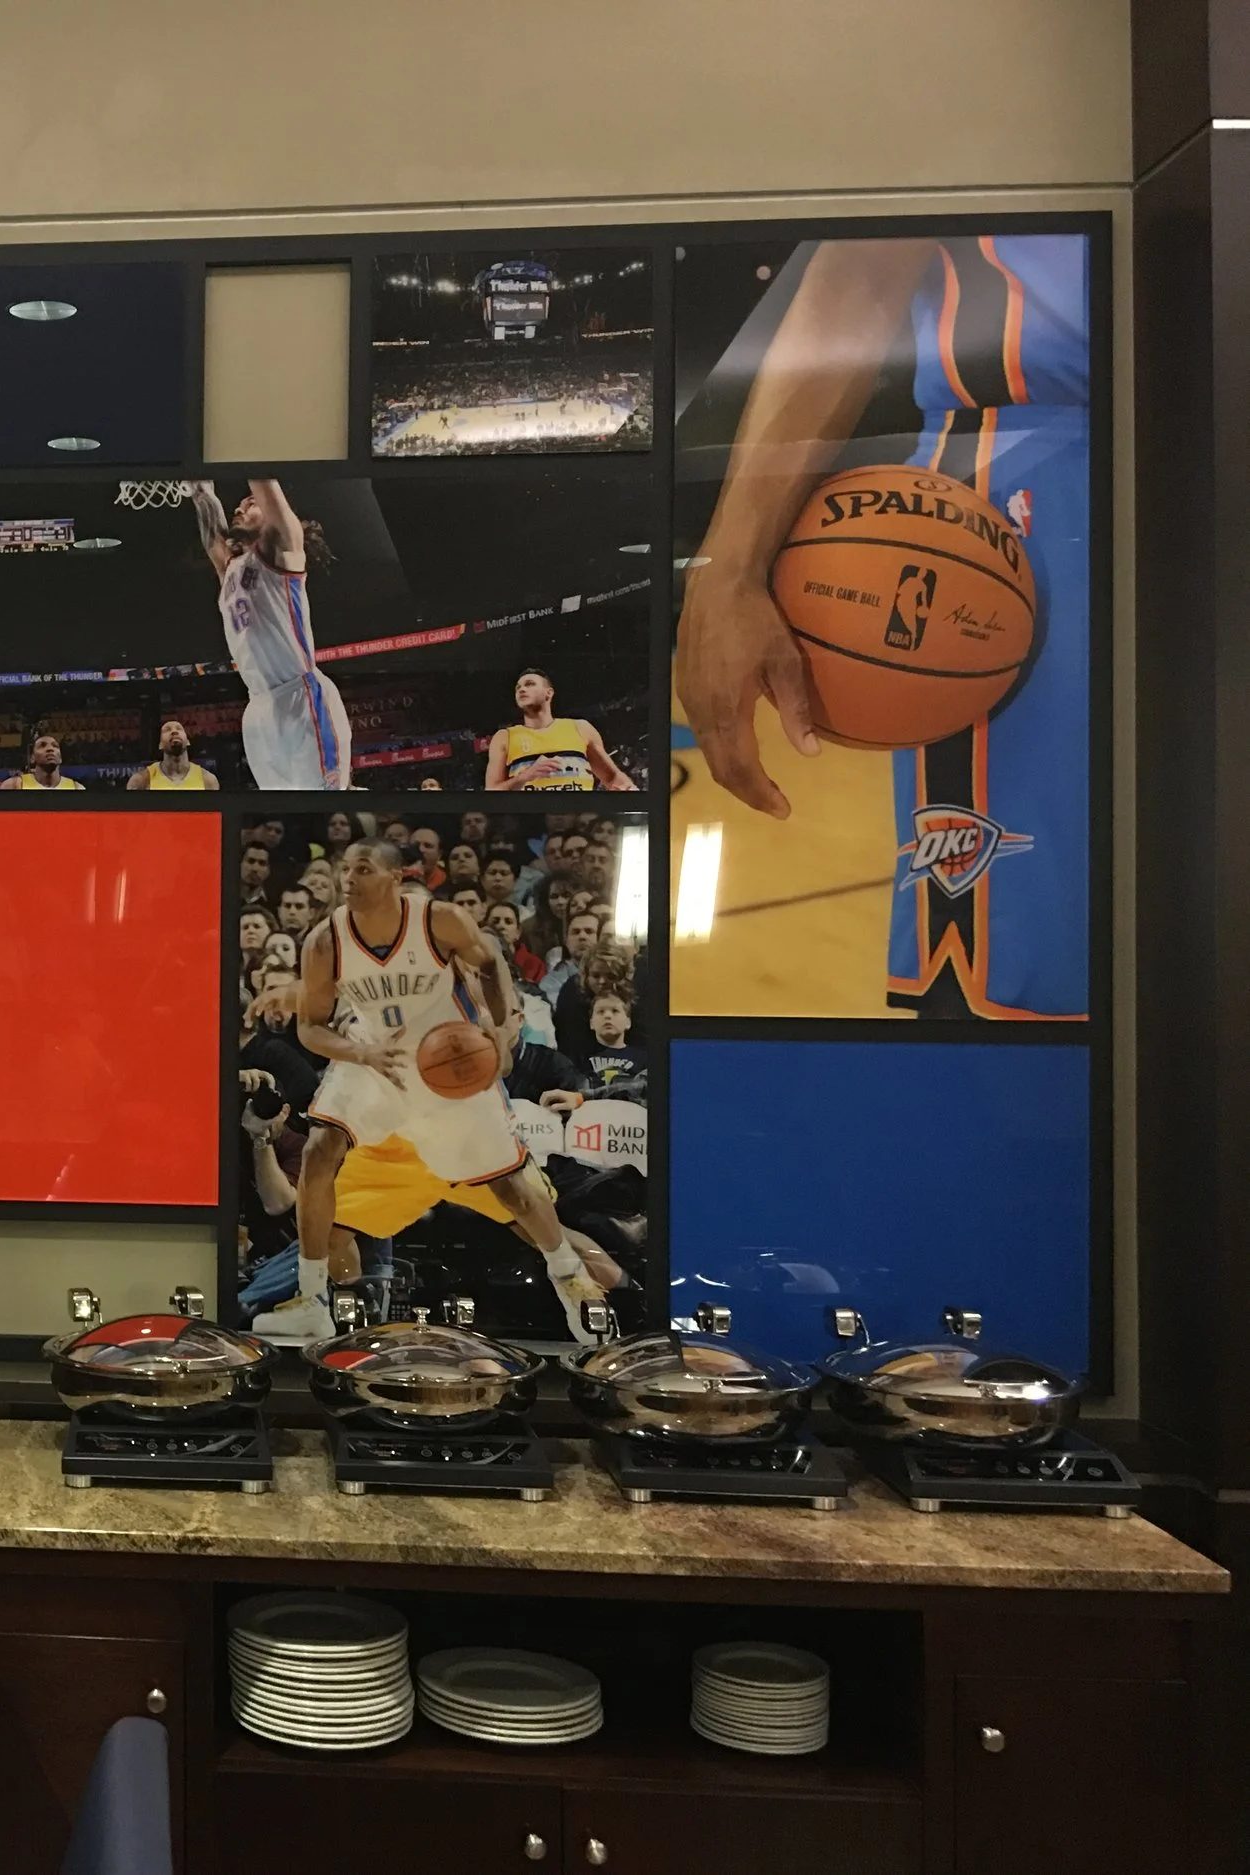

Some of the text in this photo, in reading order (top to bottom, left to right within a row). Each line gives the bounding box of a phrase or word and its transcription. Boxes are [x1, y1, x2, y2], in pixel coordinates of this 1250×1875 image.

[820, 489, 1020, 574] SPALDING
[338, 647, 353, 657] THE
[355, 640, 394, 654] THUNDER
[395, 634, 427, 648] CREDIT
[888, 630, 911, 647] NBA
[22, 674, 42, 683] BANK
[43, 673, 53, 682] OF
[54, 673, 68, 681] THE
[70, 671, 103, 681] THUNDER
[911, 827, 979, 871] OKC
[382, 1004, 404, 1028] 0
[588, 1056, 635, 1074] THUNDER
[607, 1123, 646, 1140] MID
[607, 1138, 648, 1156] BAN
